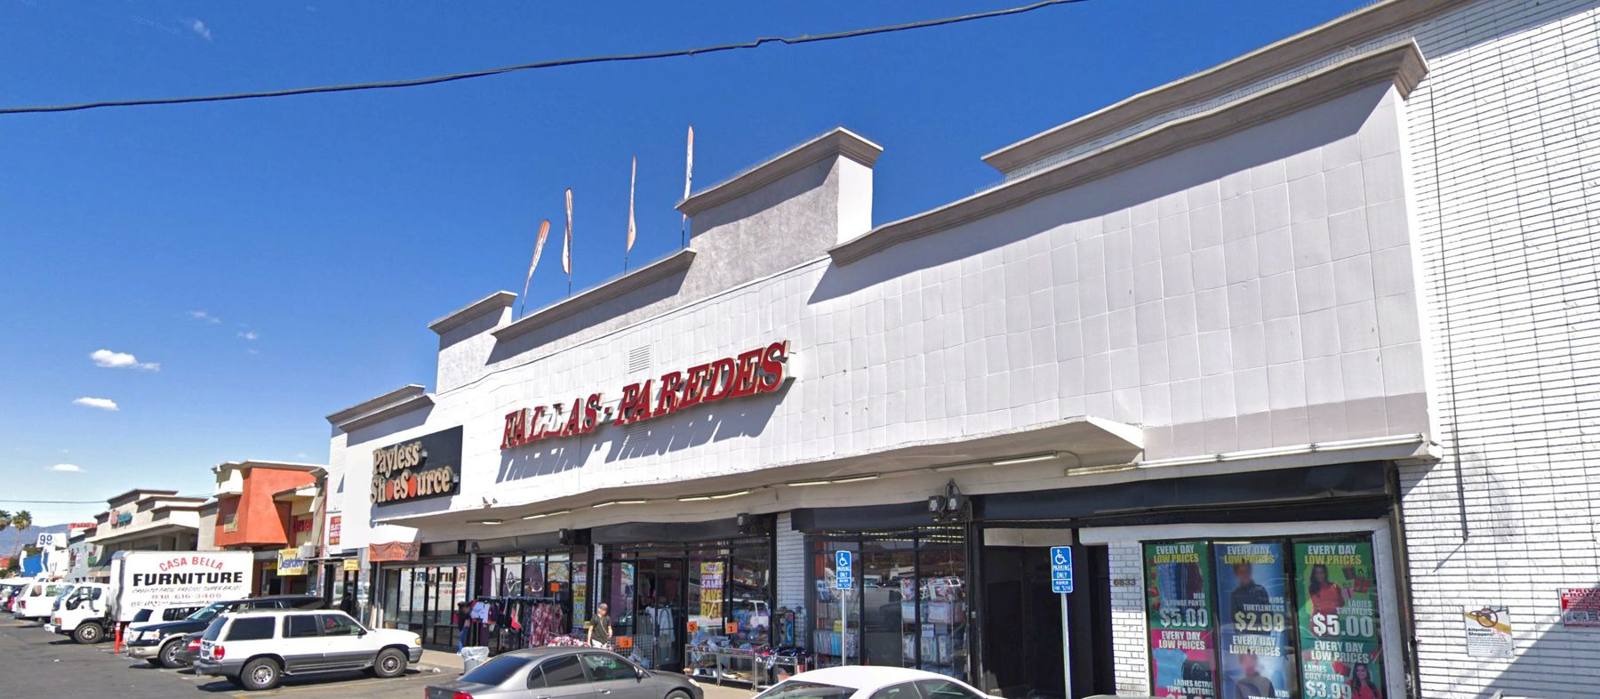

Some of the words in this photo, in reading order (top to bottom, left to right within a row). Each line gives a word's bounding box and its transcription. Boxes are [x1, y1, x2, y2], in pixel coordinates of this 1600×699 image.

[500, 392, 604, 450] FALLAS
[613, 340, 790, 427] PAREDES
[372, 441, 422, 478] Payless
[370, 468, 453, 504] ShoeSource
[1156, 545, 1178, 554] EVERY
[1180, 544, 1195, 554] DAY
[1227, 546, 1252, 555] EVERY
[1254, 546, 1270, 555] DAY
[1308, 545, 1336, 555] EVERY
[1338, 545, 1356, 554] DAY
[160, 558, 188, 572] CASA
[192, 556, 224, 570] BELLA
[1154, 554, 1170, 564] LOW
[1171, 553, 1199, 564] PRICES
[1304, 555, 1325, 564] LOW
[1327, 555, 1362, 564] PRICES
[133, 572, 243, 586] FURNITURE
[1243, 604, 1285, 612] TURTLENECKS
[1160, 608, 1208, 627] $5.00
[1234, 611, 1284, 632] $2.99
[1312, 612, 1374, 637] $5.00
[1161, 630, 1184, 640] EVERY
[1186, 631, 1200, 640] DAY
[1232, 634, 1256, 645] EVERY
[1258, 636, 1276, 646] DAY
[1159, 640, 1176, 648] LOW
[1177, 640, 1205, 650] PRICES
[1230, 644, 1248, 654] LOW
[1250, 646, 1280, 656] PRICES
[1314, 640, 1342, 651] EVERY
[1346, 642, 1364, 652] DAY
[1311, 650, 1332, 660] LOW
[1334, 652, 1369, 664] PRICES
[1275, 689, 1290, 698] KIDS
[1305, 680, 1352, 699] $3.99
